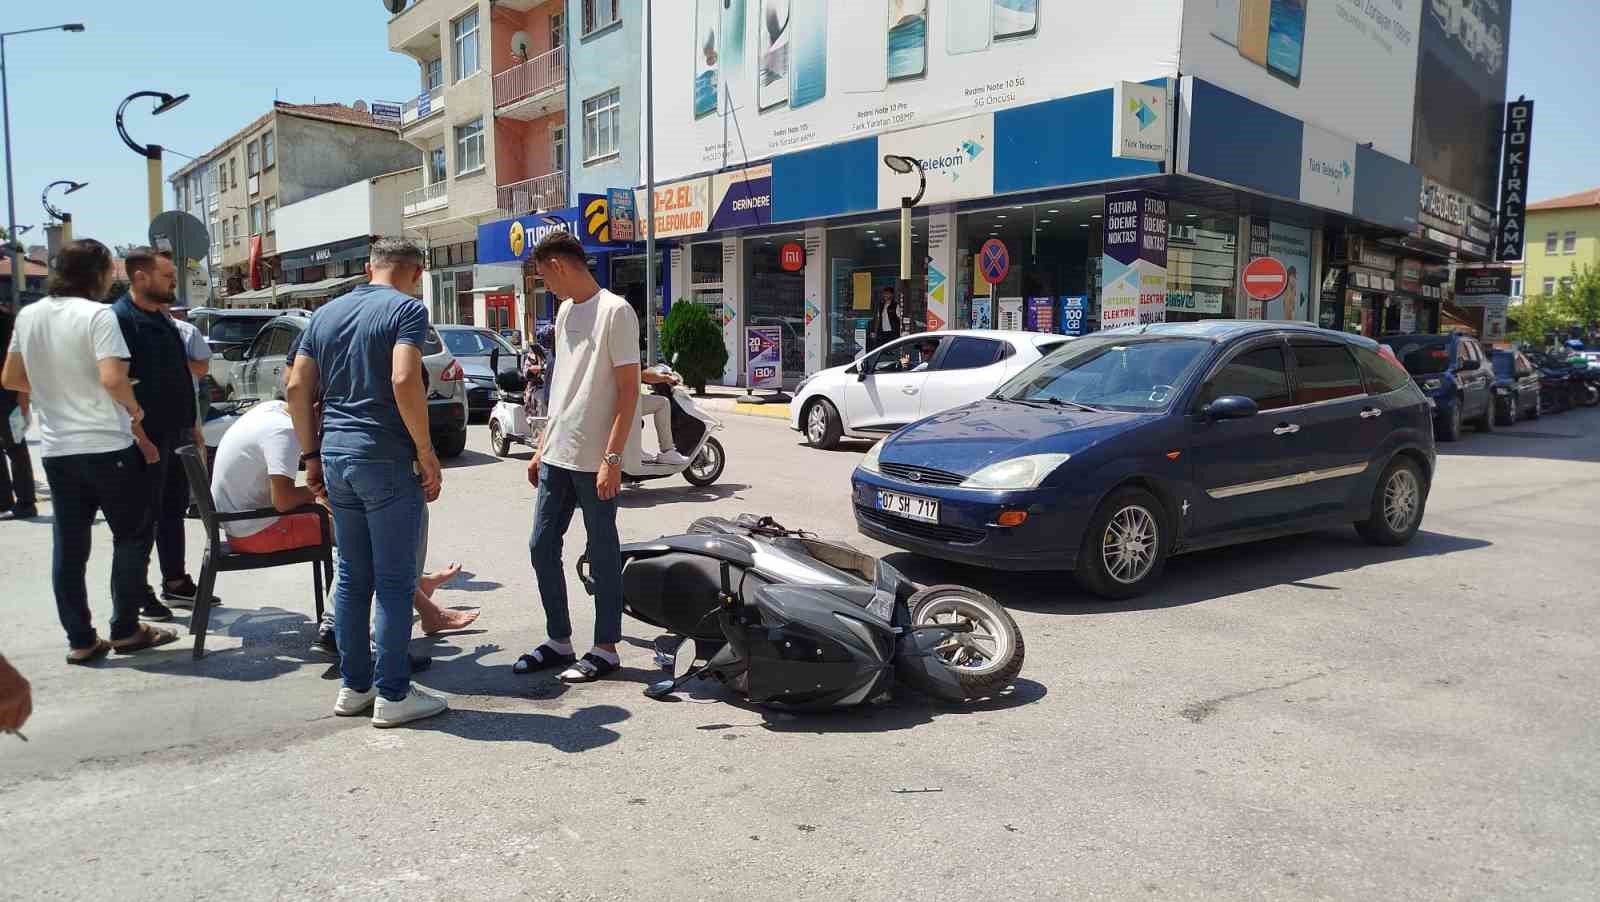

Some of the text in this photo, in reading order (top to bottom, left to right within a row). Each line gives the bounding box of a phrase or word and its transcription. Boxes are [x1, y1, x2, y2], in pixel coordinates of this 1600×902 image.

[987, 82, 1004, 91] Note
[1006, 79, 1014, 88] 10
[1015, 77, 1025, 87] 5G
[1510, 106, 1527, 145] OTO
[918, 155, 963, 171] Telekom
[732, 195, 771, 211] DERİNDERE
[1109, 200, 1137, 215] FATURA
[1144, 198, 1166, 215] FATURA
[1108, 215, 1137, 230] ÖDEME
[1144, 215, 1166, 234] ÖDEME
[1107, 230, 1137, 245] NOKTASI
[1143, 234, 1165, 251] NOKTASI
[1065, 309, 1083, 320] 100
[1066, 319, 1080, 329] GB
[749, 337, 761, 346] 20
[882, 492, 937, 517] 07 SH 717
